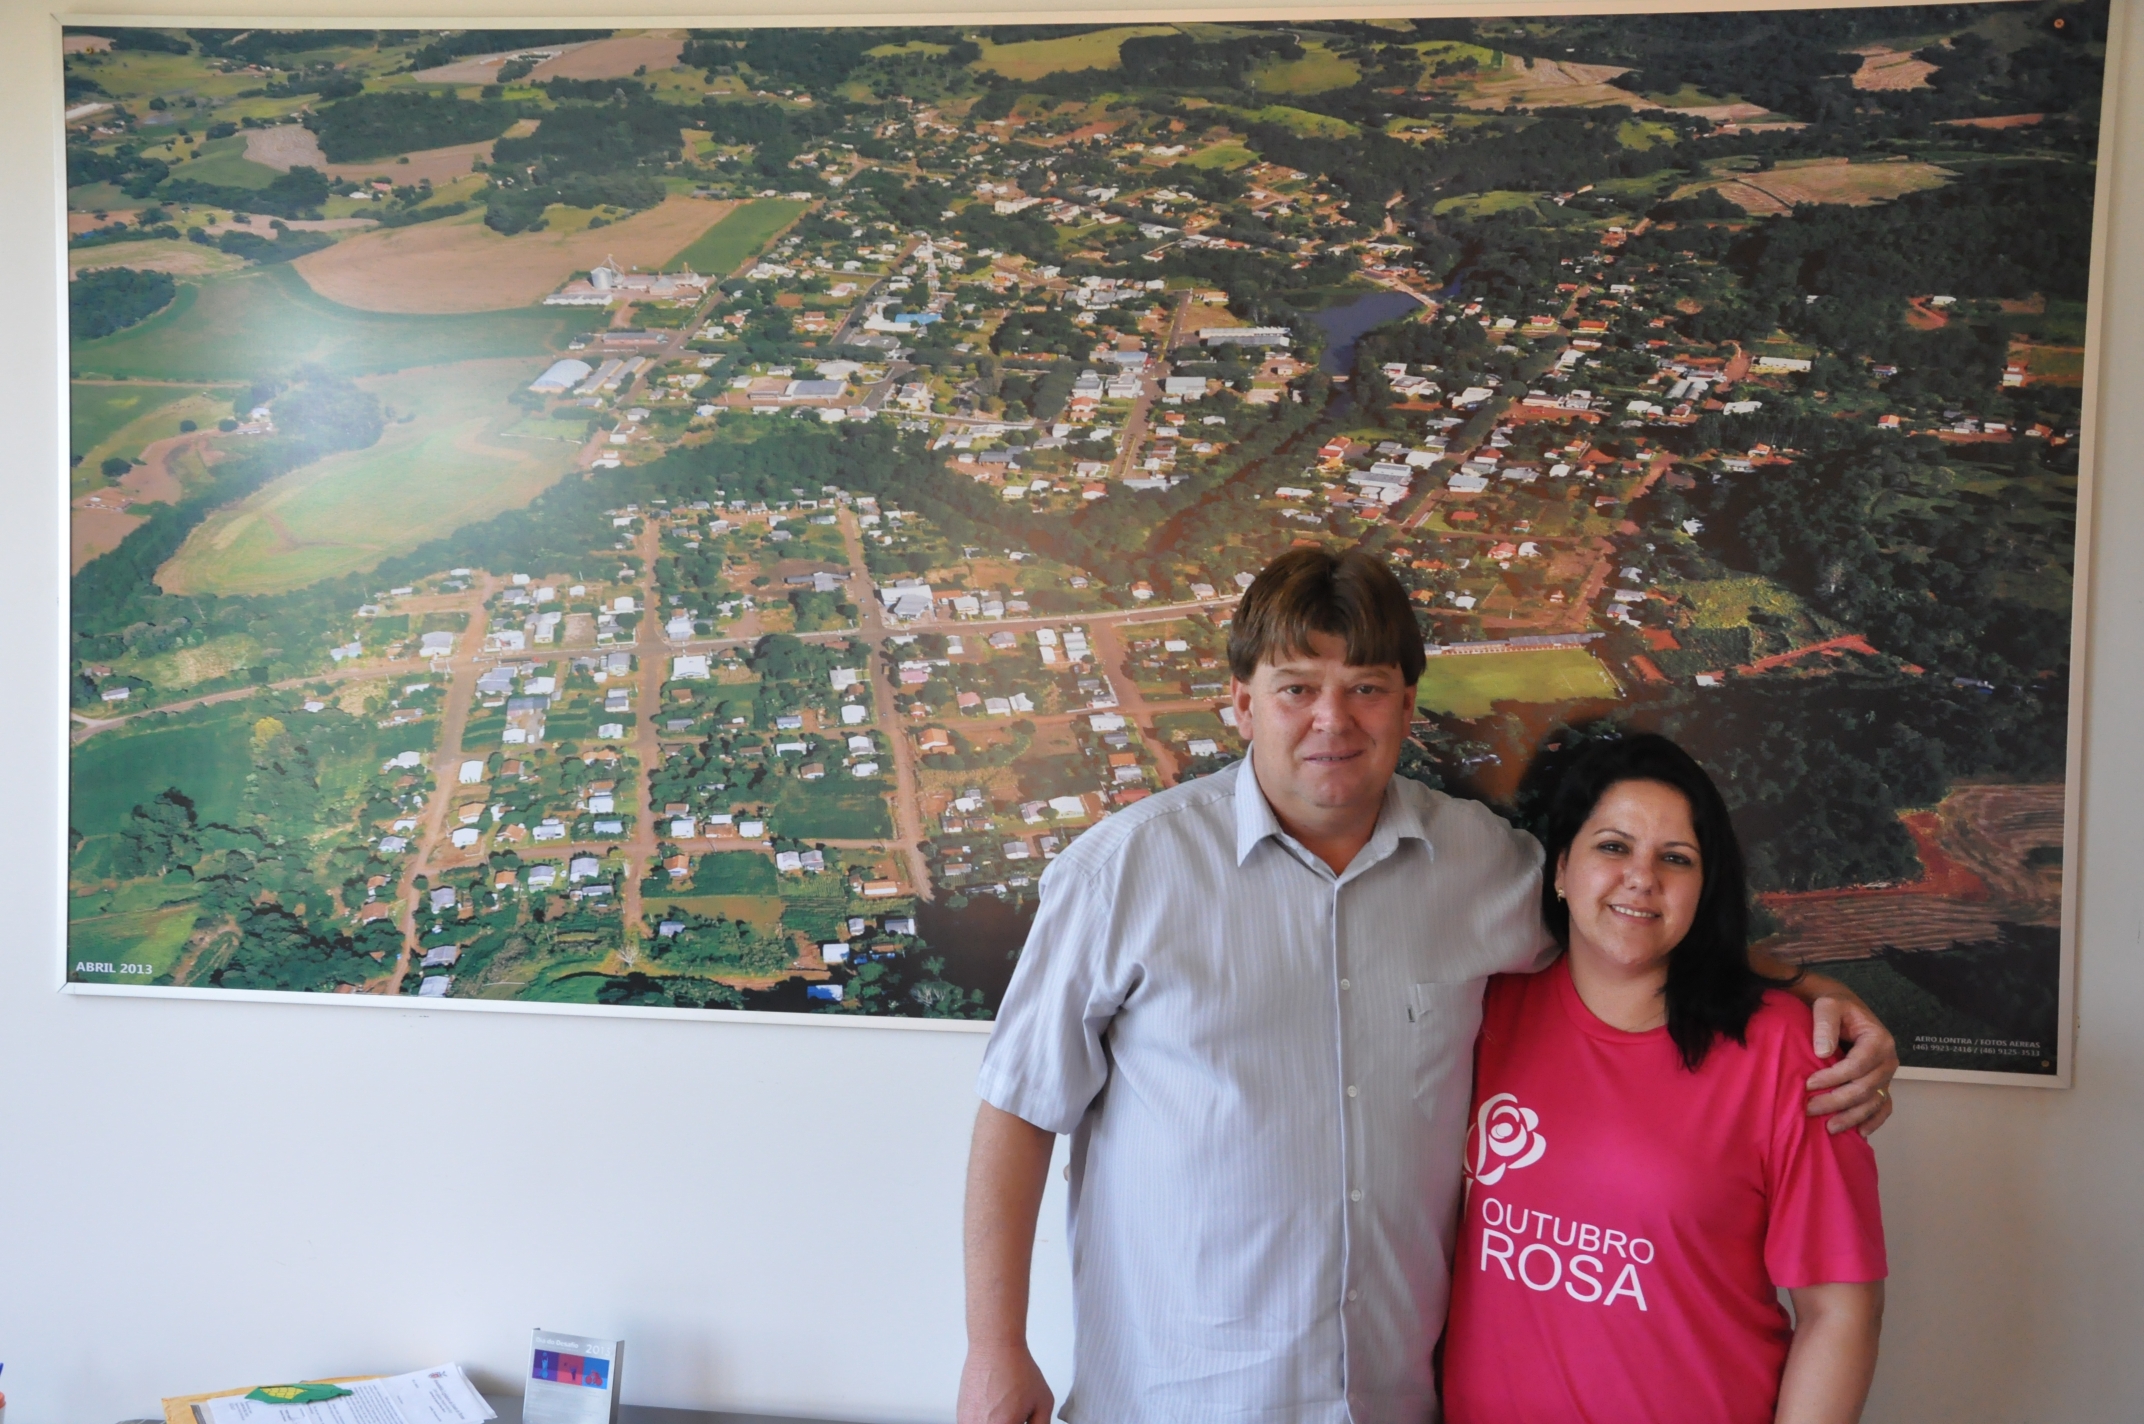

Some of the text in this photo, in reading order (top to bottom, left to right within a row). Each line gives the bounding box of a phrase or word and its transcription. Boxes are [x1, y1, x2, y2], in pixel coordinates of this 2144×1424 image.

[76, 962, 153, 975] ABRIL 2013
[1915, 1035, 1937, 1043] AERO
[1939, 1036, 1972, 1045] LONTRA
[1980, 1038, 2007, 1047] FOTOS
[1482, 1197, 1655, 1264] OUTUBRO
[1480, 1227, 1648, 1311] ROSA
